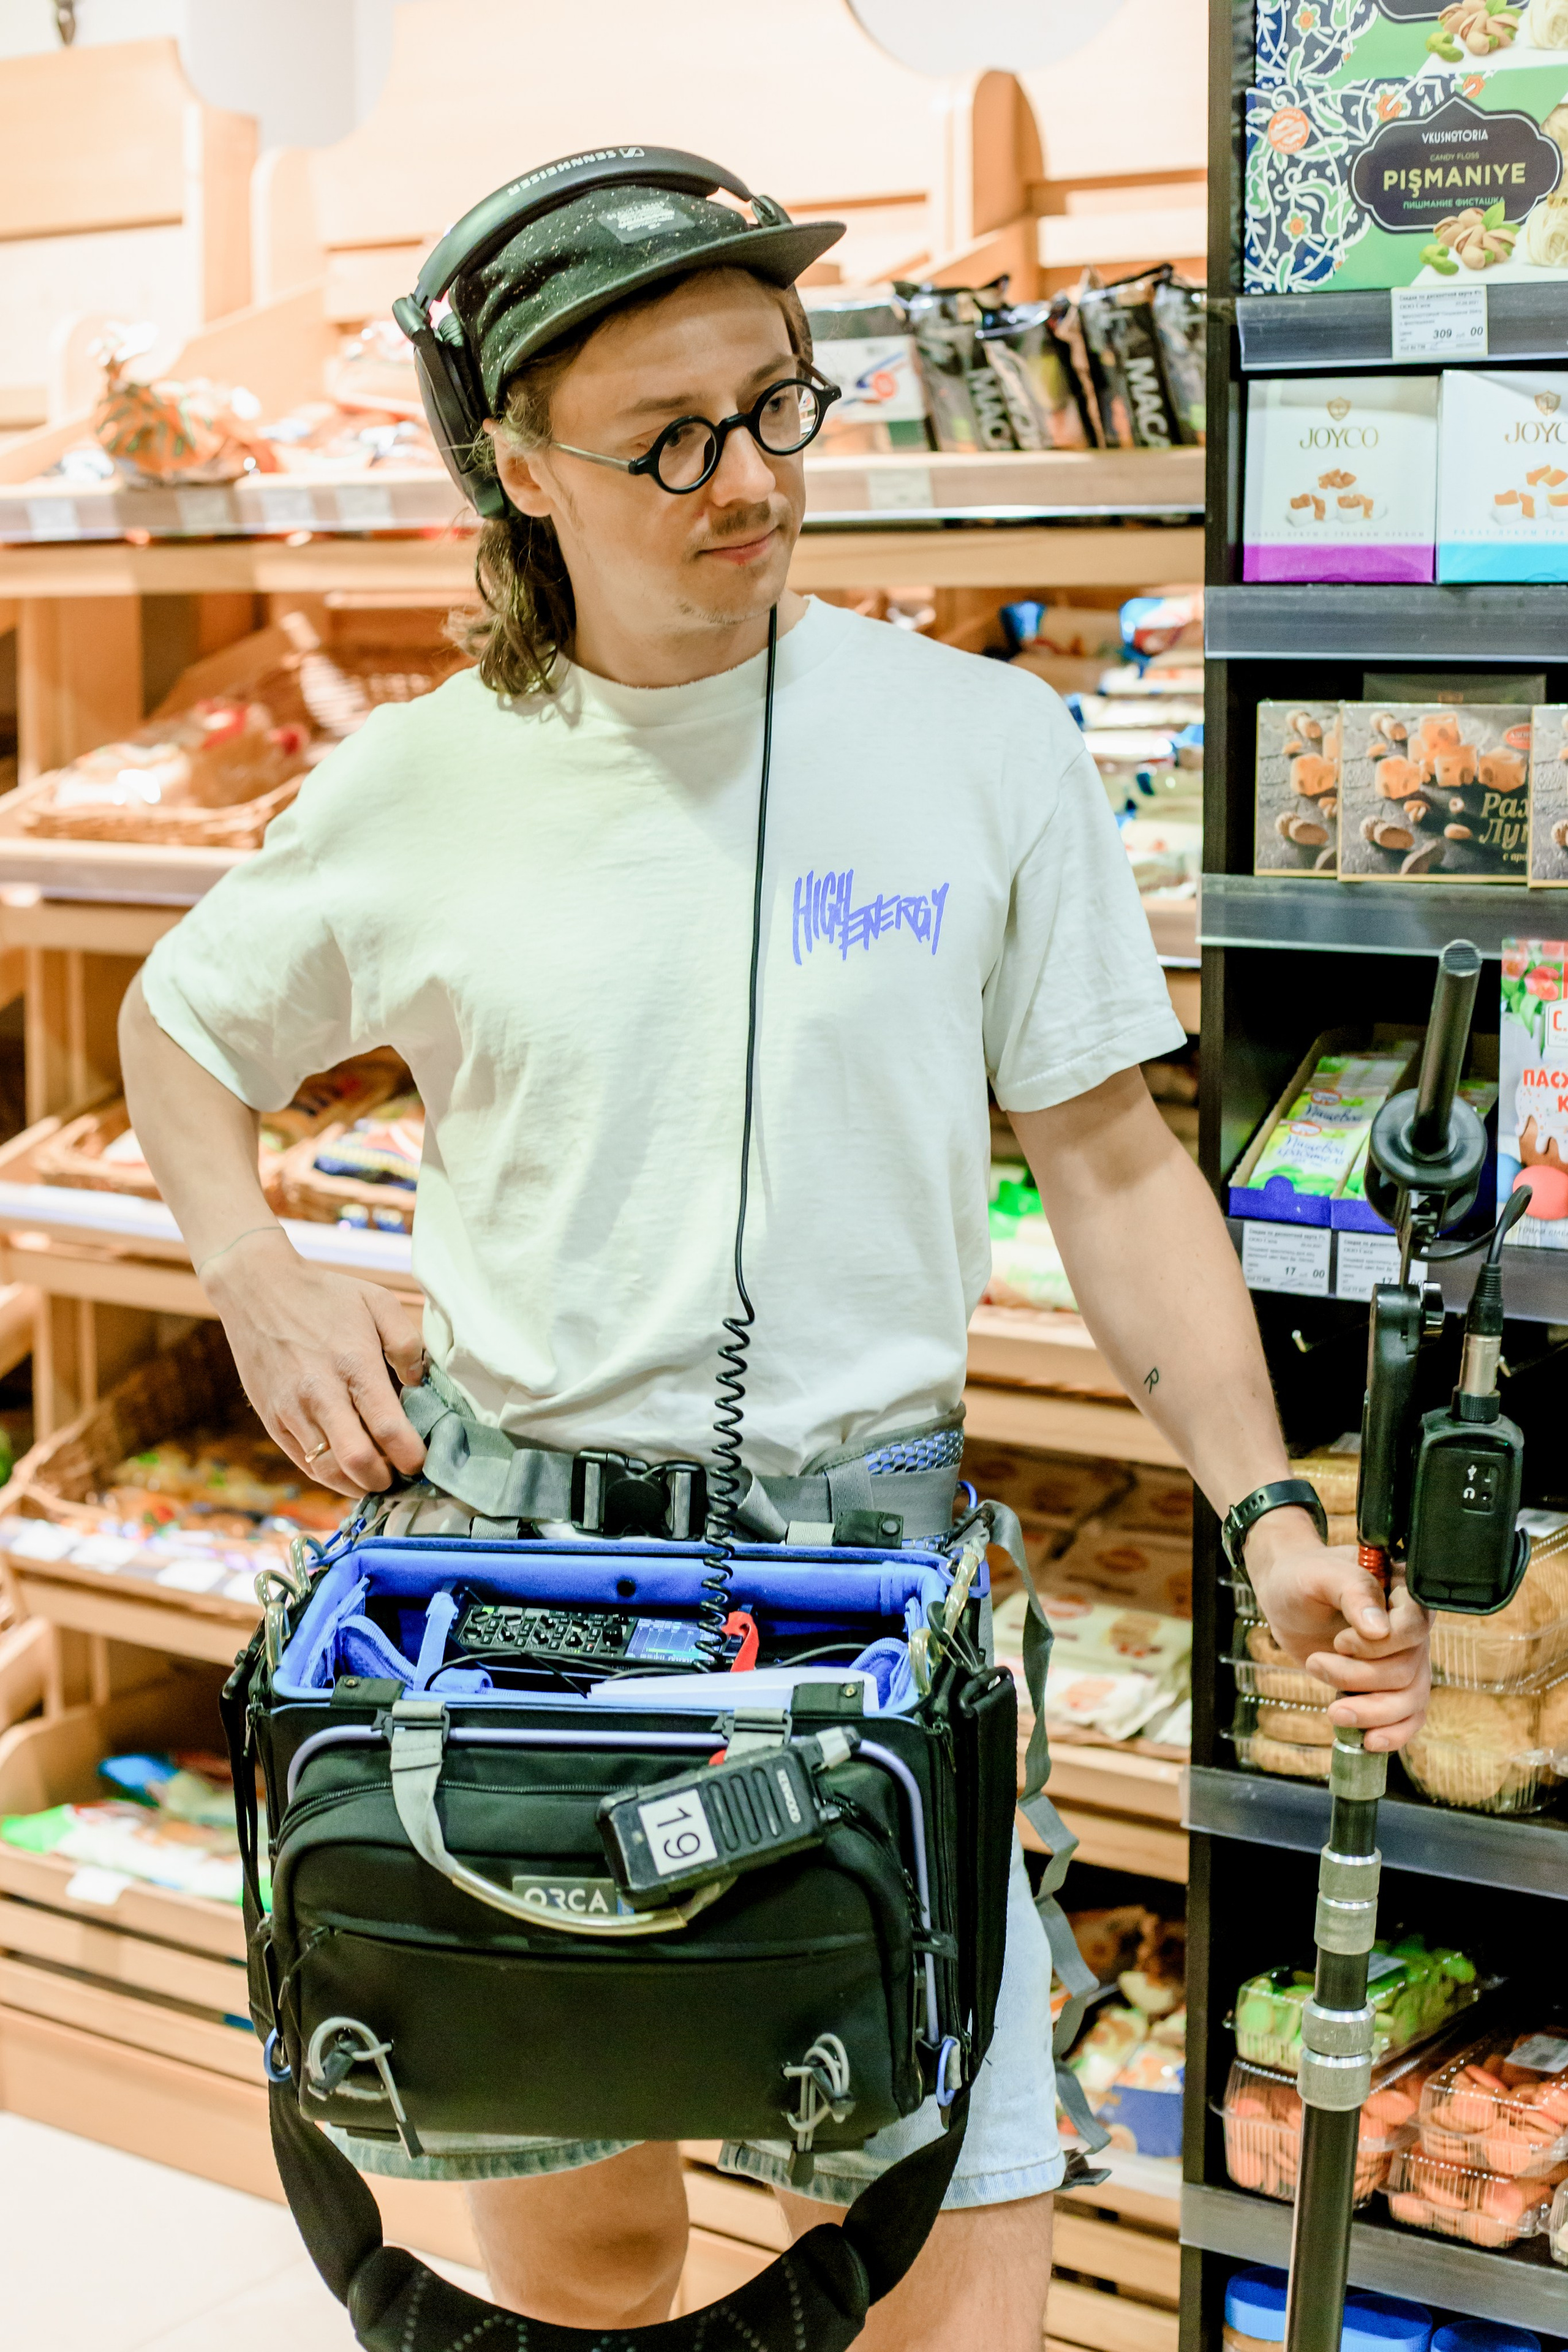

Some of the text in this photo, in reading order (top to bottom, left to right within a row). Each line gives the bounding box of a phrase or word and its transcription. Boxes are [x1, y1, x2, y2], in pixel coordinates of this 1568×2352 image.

[1430, 151, 1480, 162] CANDY FLOSS
[507, 149, 616, 197] SENNHEISER
[1382, 162, 1526, 199] PIŞMANIYE
[1403, 198, 1454, 210] ПИШМАНИЕ
[1433, 328, 1452, 339] 309
[1471, 326, 1483, 336] 00
[1300, 428, 1379, 450] JOYCO
[793, 869, 949, 965] HIGH ENERGY
[1285, 1266, 1295, 1276] 17
[1313, 1269, 1325, 1278] 00
[657, 1807, 699, 1858] 19
[524, 1887, 608, 1913] ORCA
